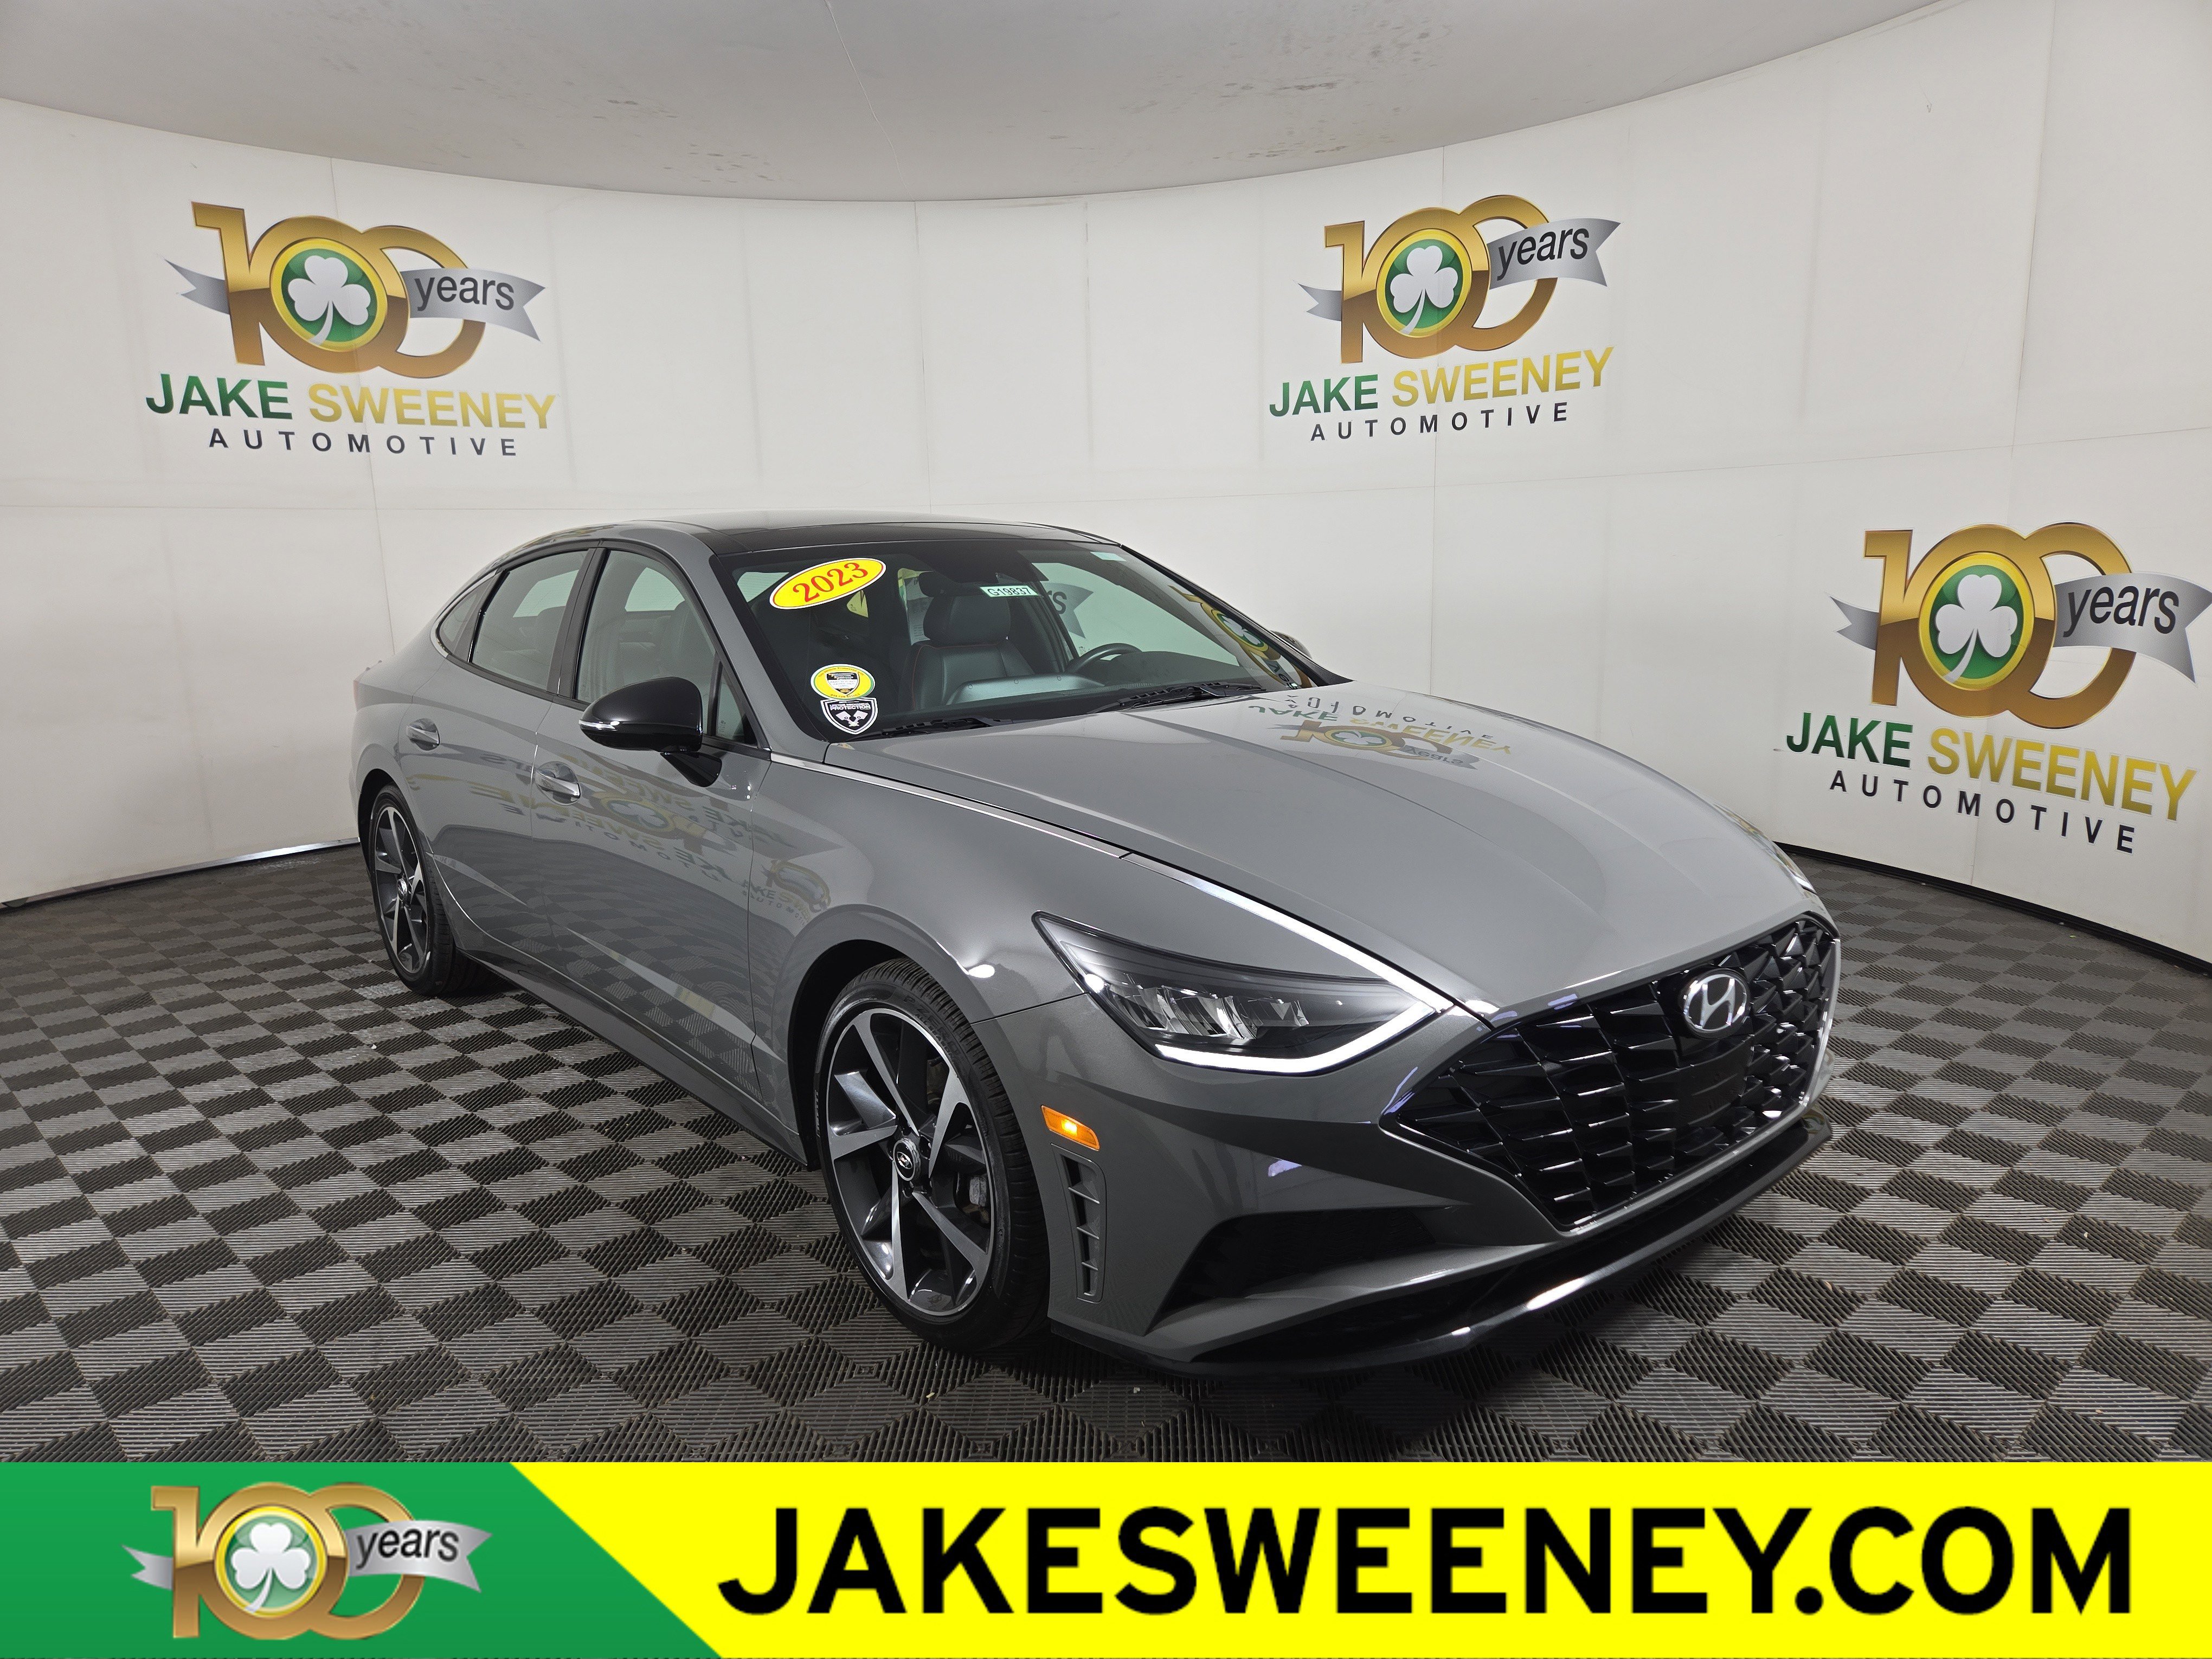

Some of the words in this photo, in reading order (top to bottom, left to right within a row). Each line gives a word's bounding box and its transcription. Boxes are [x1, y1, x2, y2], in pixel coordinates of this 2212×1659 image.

[1324, 194, 1559, 364] 100
[1496, 227, 1590, 280] years
[191, 201, 486, 378] 100
[414, 275, 516, 311] years
[145, 373, 293, 420] JAKE
[308, 383, 556, 429] SWEENEY
[1269, 374, 1379, 417] JAKE
[1391, 346, 1615, 407] SWEENEY
[208, 428, 517, 456] AUTOMOTIVE
[1310, 402, 1568, 441] AUTOMOTIVE
[792, 562, 869, 602] 2023
[987, 587, 1032, 596] G19837
[1863, 522, 2137, 730] 100
[2063, 585, 2180, 638] years
[1785, 712, 1914, 768] JAKE
[1927, 727, 2197, 821] SWEENEY
[1830, 770, 2136, 854] AUTOMOTIVE
